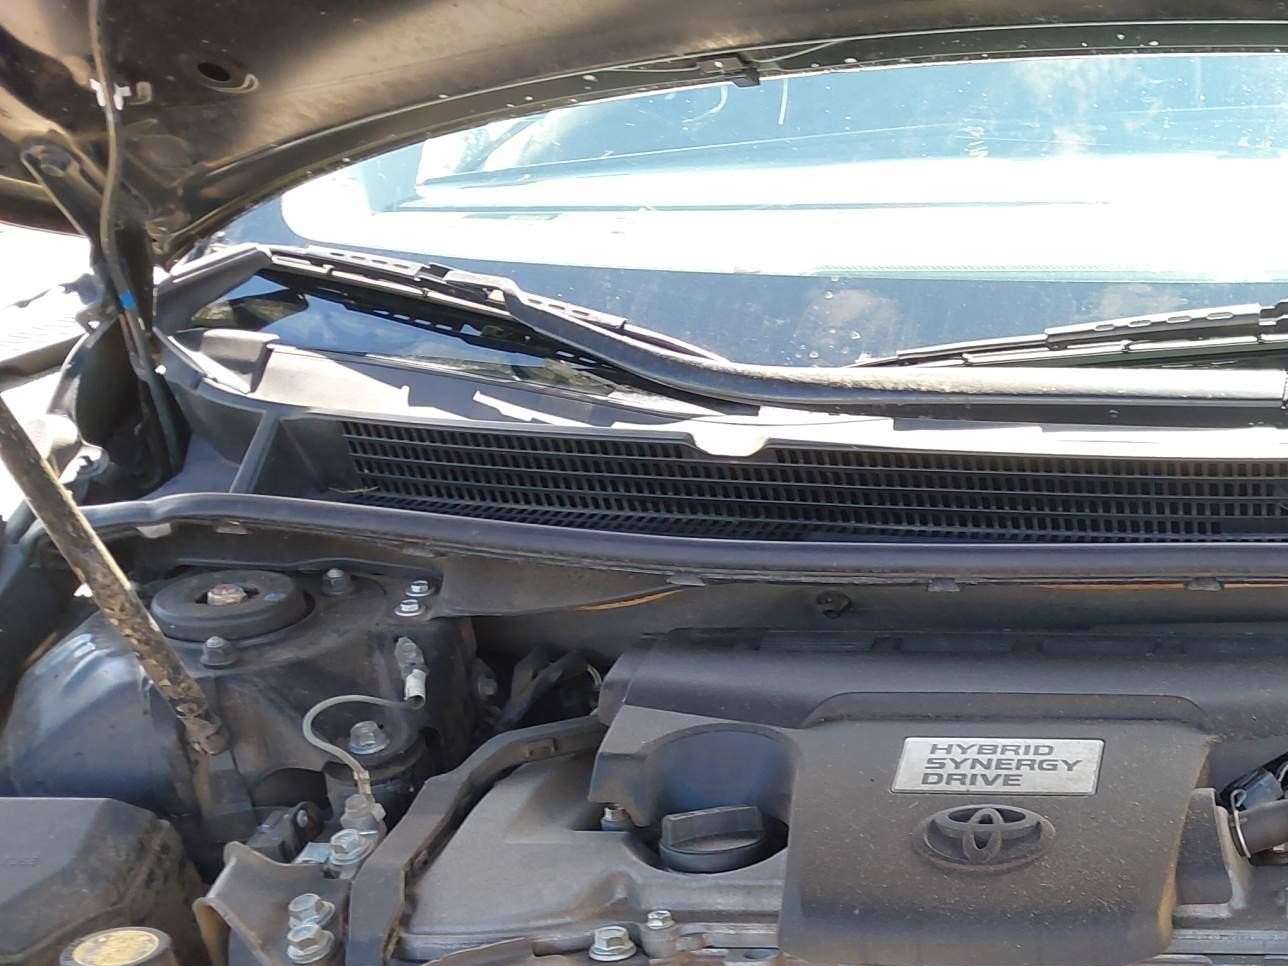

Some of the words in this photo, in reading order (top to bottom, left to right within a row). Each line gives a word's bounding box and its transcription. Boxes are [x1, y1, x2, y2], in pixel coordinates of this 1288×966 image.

[930, 743, 1055, 756] HYBRID
[925, 758, 1083, 771] SYNERGY
[921, 773, 1023, 786] DRIVE
